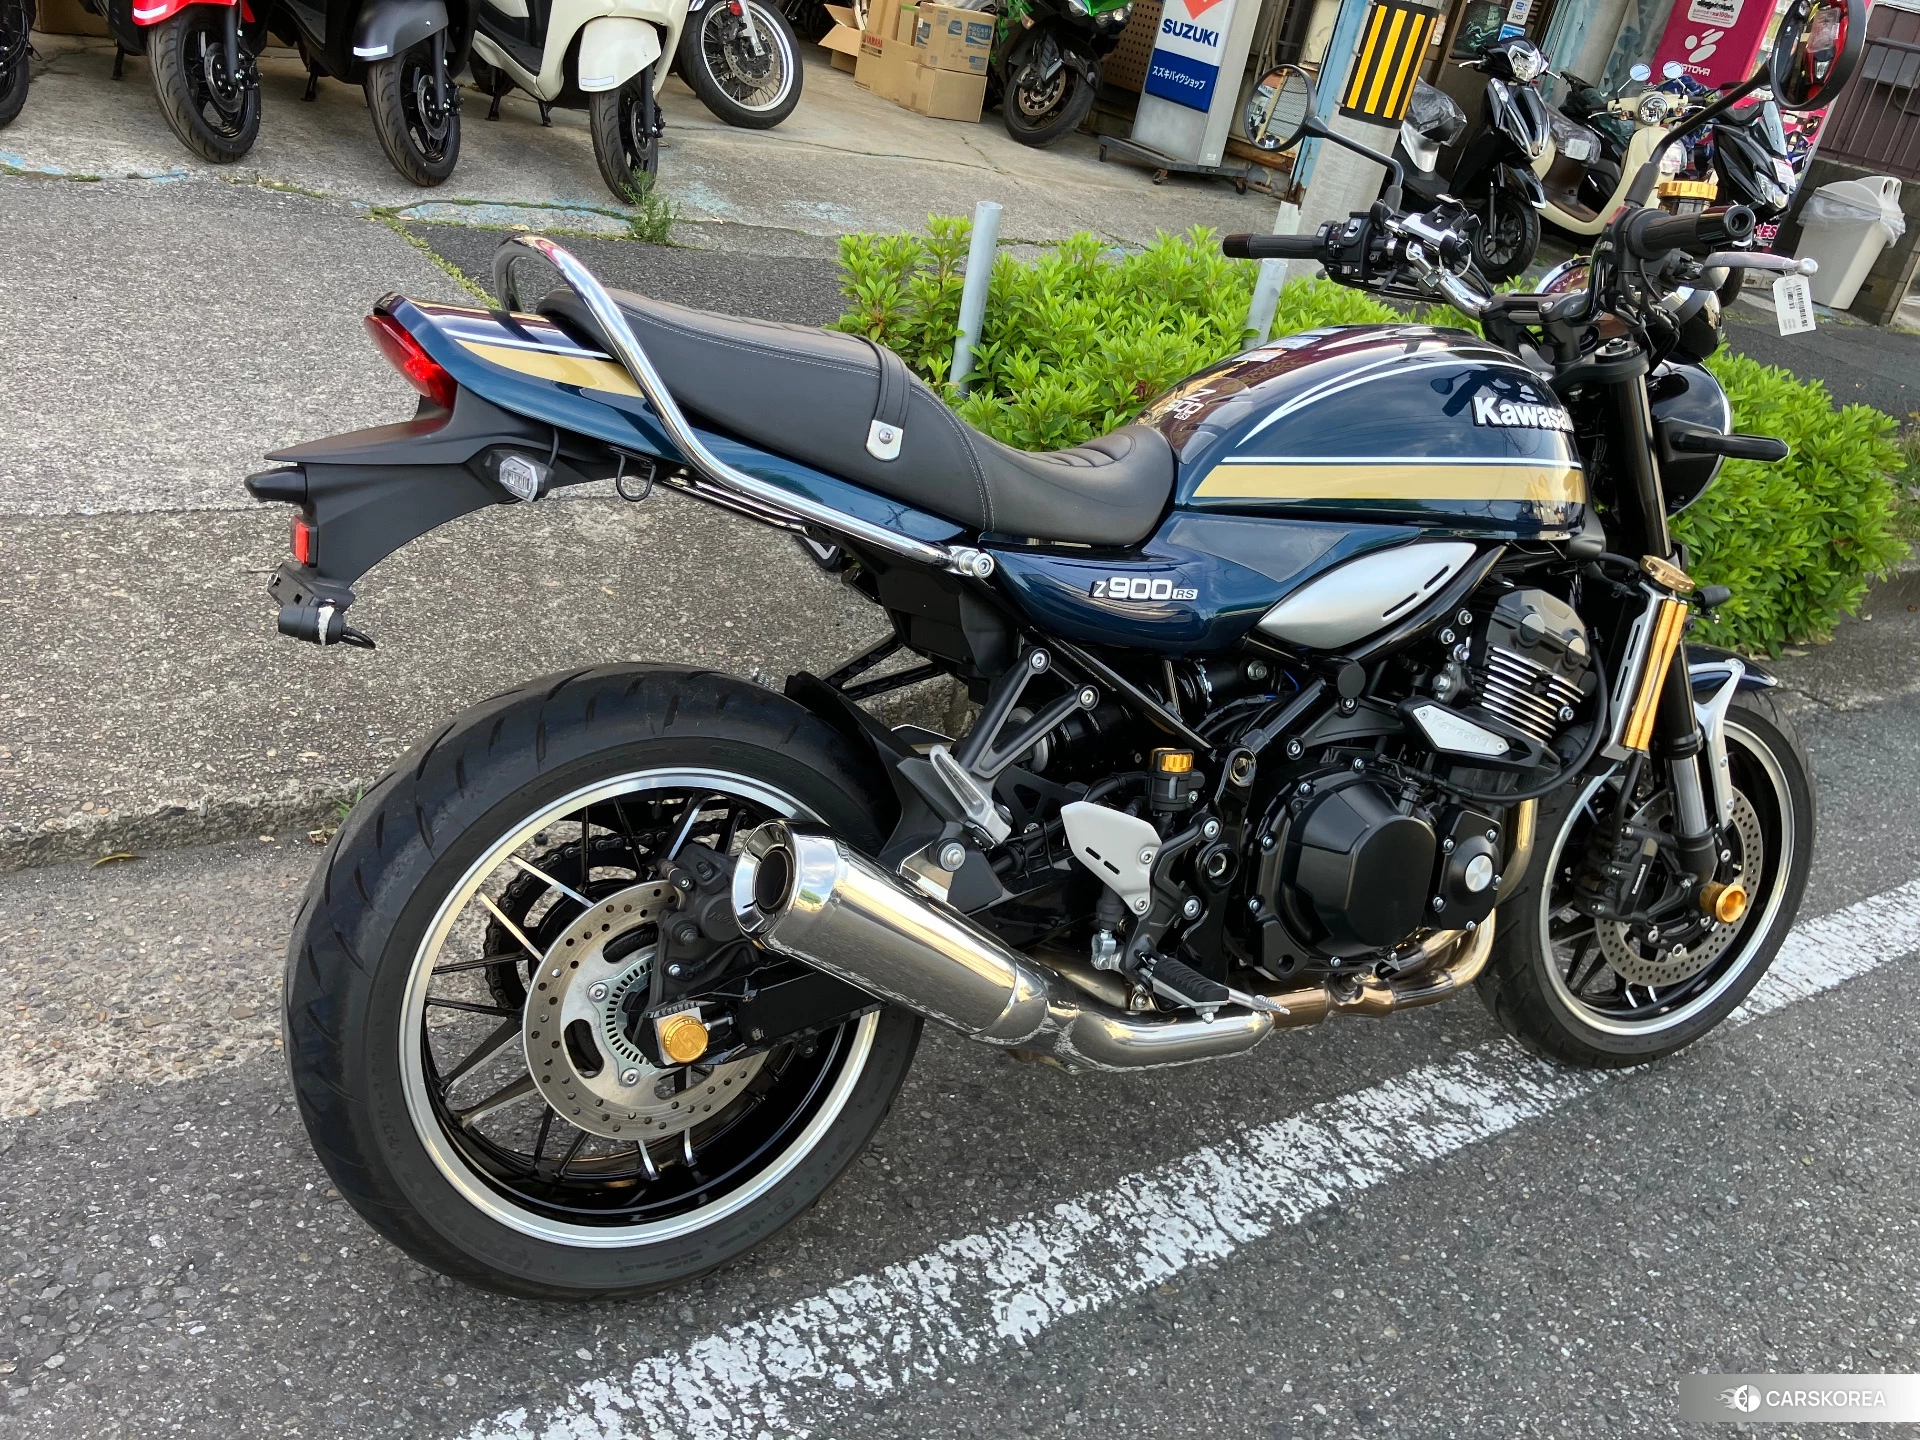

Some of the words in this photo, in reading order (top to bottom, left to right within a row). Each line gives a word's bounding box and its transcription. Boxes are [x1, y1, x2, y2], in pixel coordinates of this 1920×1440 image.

[1162, 18, 1219, 47] SUZUKI
[1152, 65, 1206, 90] スズキバイクショップ
[1681, 62, 1711, 76] ATOYA
[1473, 396, 1575, 433] Kawasa
